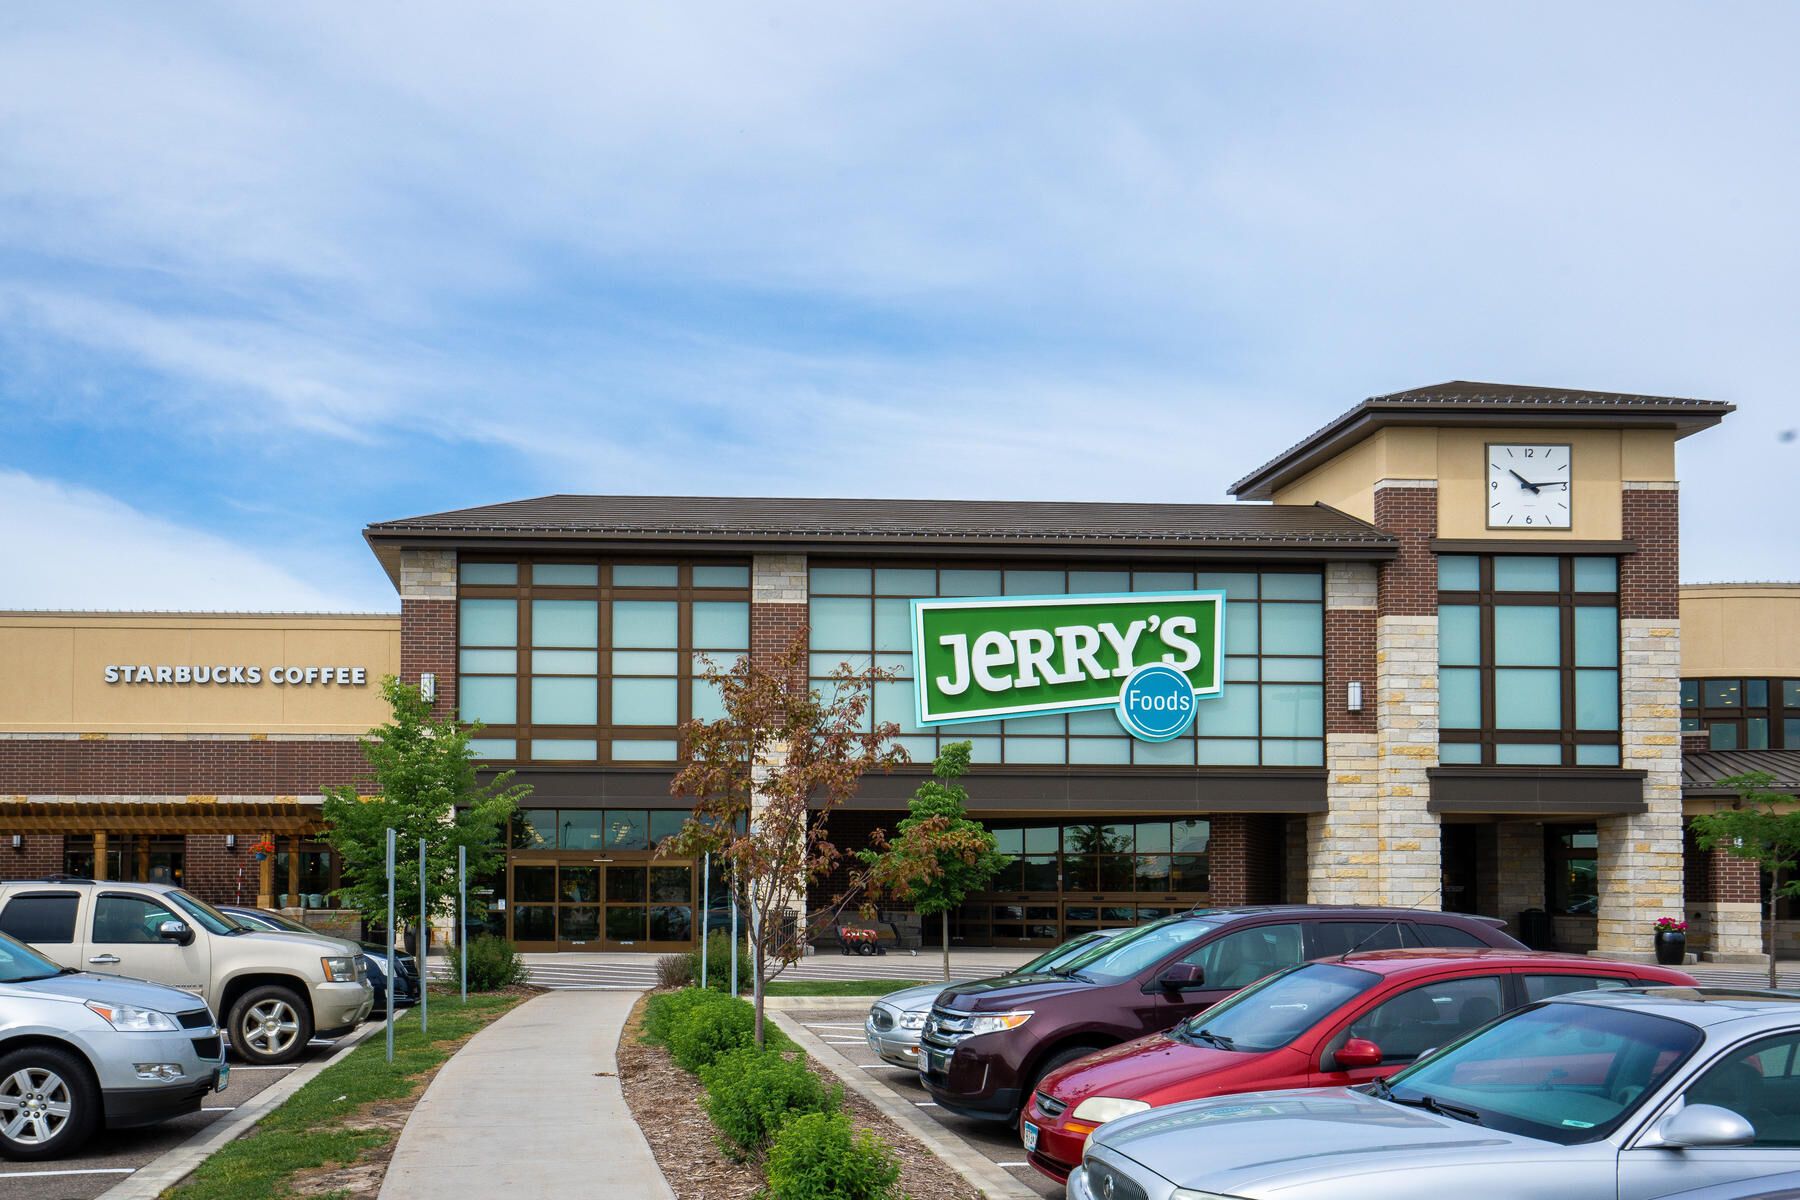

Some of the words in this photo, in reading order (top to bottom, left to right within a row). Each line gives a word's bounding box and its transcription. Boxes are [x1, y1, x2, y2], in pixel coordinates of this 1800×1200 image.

[1525, 448, 1534, 458] 12
[1491, 481, 1498, 490] 9
[1526, 515, 1533, 524] 6
[104, 665, 261, 684] STARBUCKS
[268, 666, 366, 685] COFFEE
[1129, 690, 1190, 711] Foods
